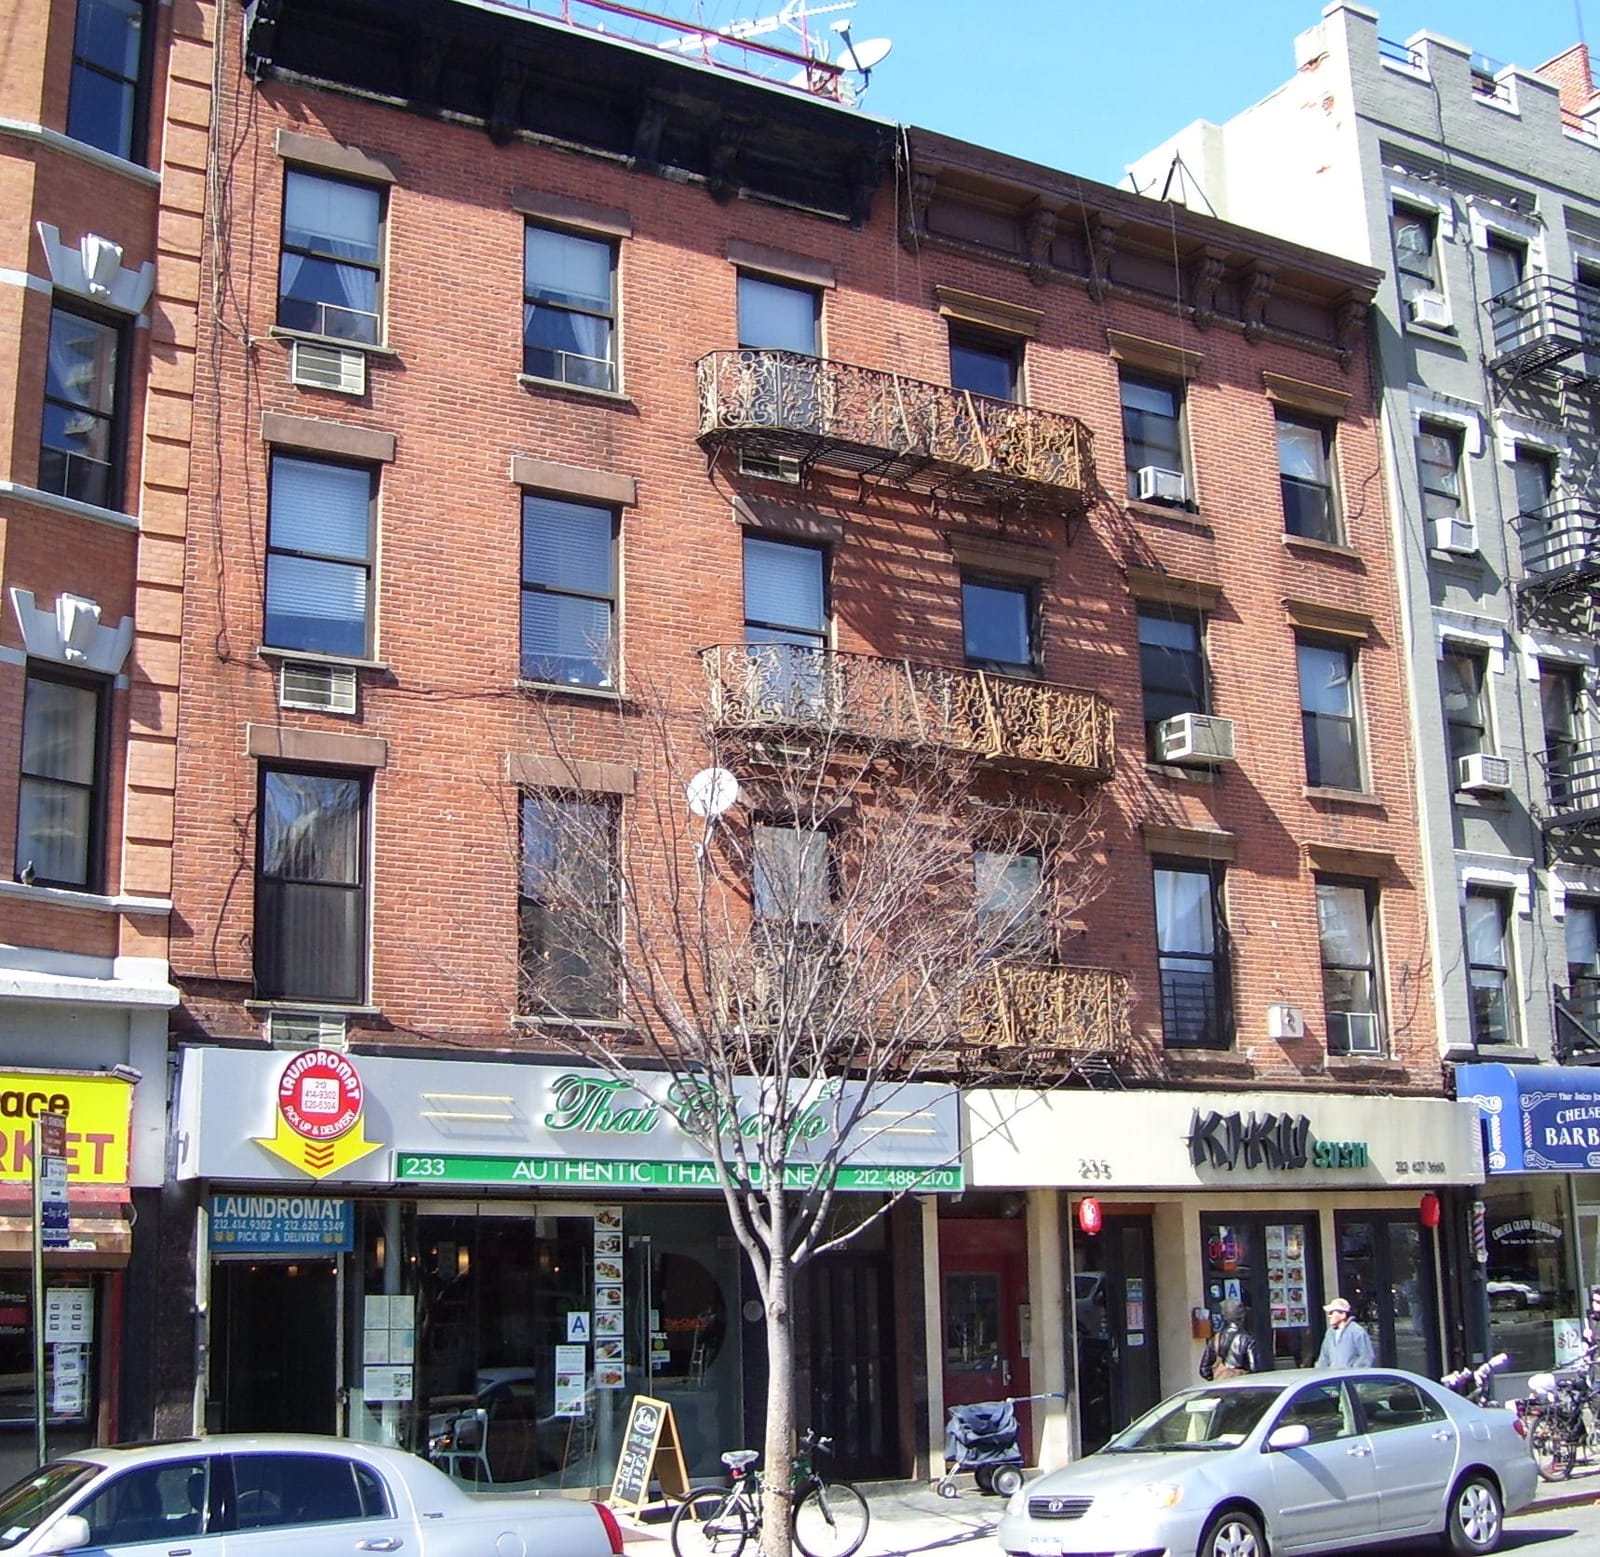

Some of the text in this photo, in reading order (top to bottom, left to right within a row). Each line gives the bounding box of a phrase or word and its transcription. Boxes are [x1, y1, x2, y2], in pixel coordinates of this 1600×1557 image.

[280, 1052, 360, 1100] LAUNDROMAT
[544, 1073, 661, 1133] Thai
[284, 1105, 302, 1126] PICK
[299, 1120, 313, 1131] UP
[312, 1125, 320, 1135] &
[1181, 1107, 1311, 1171] KIKU
[1314, 1141, 1369, 1168] SUSHI
[406, 1158, 445, 1176] 233
[512, 1161, 651, 1182] AUTHENTIC
[213, 1197, 345, 1219] LAUNDROMAT
[237, 1232, 257, 1242] PICK
[261, 1232, 271, 1242] UP
[284, 1232, 321, 1243] DELIVERY
[1228, 1283, 1239, 1298] A
[571, 1315, 586, 1333] A
